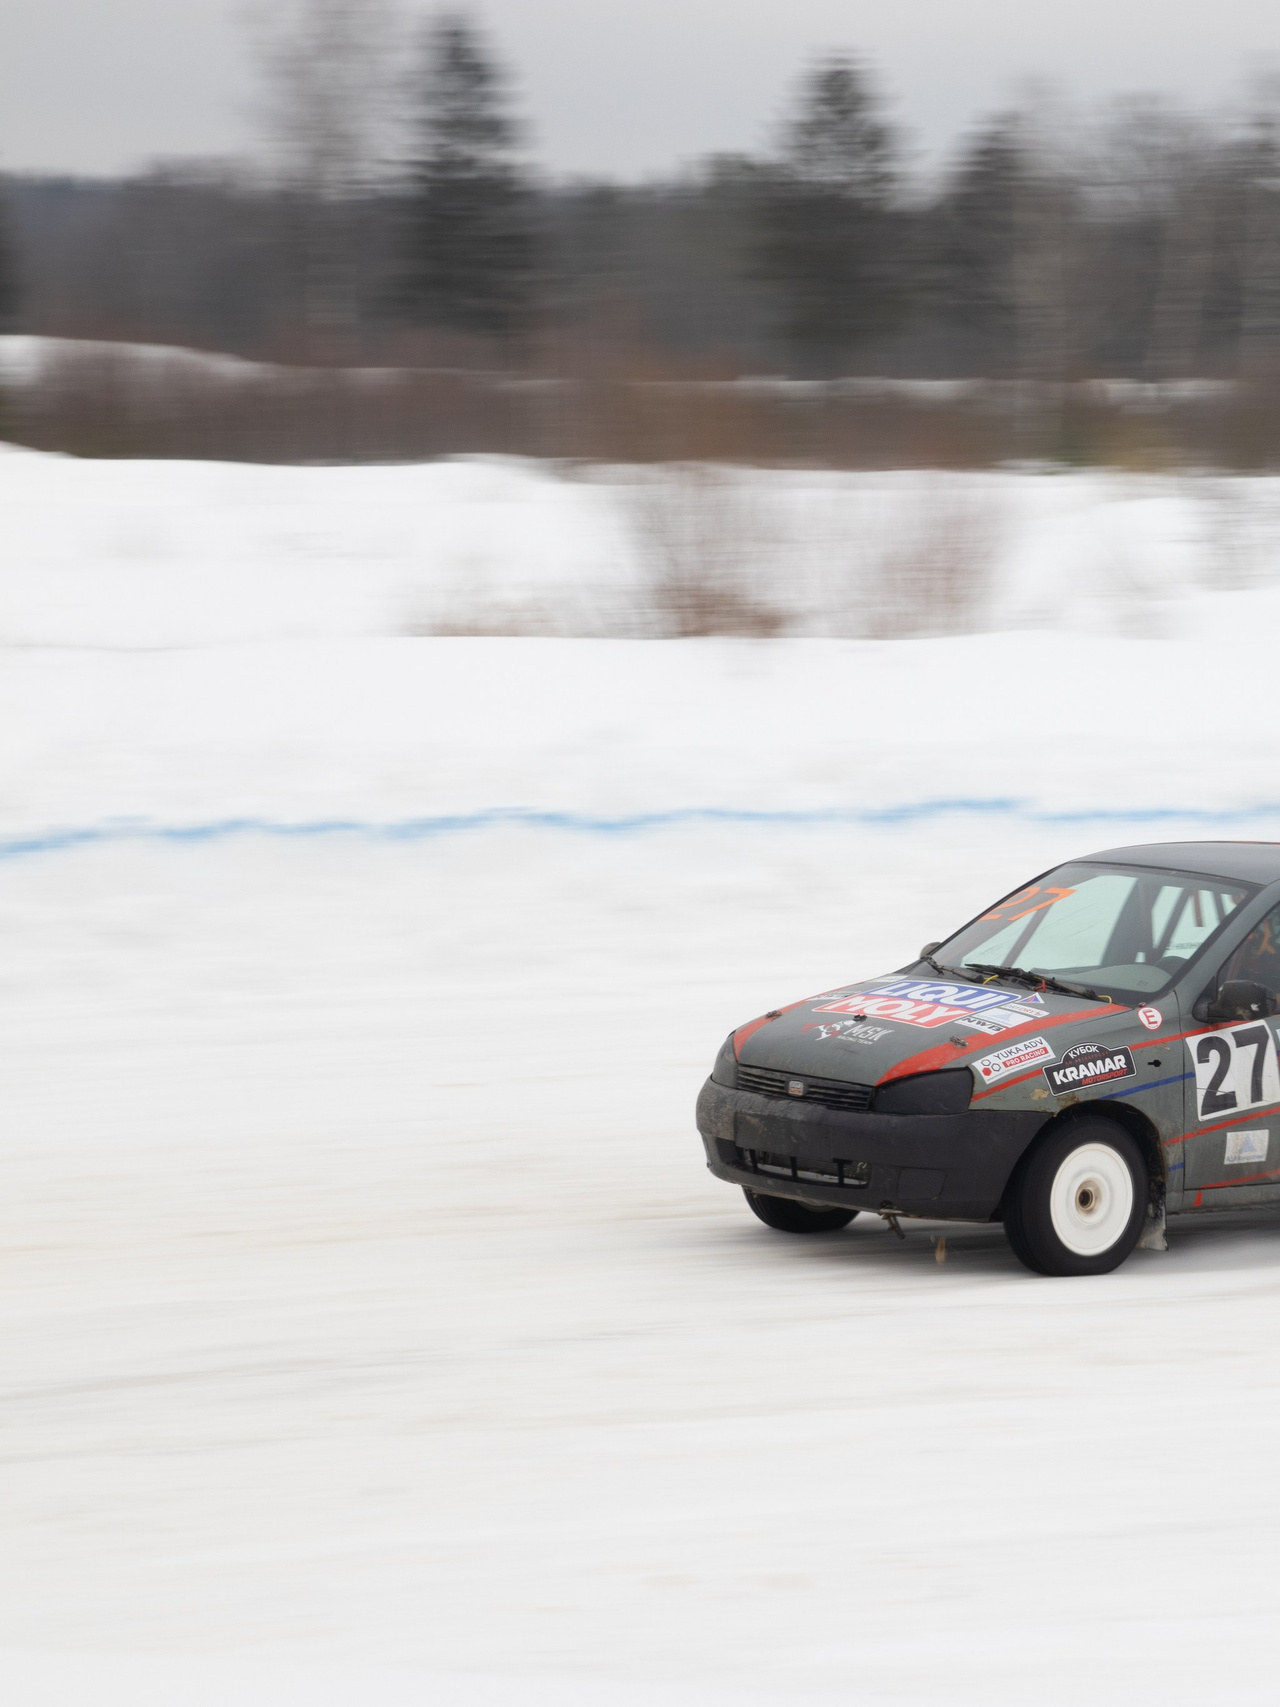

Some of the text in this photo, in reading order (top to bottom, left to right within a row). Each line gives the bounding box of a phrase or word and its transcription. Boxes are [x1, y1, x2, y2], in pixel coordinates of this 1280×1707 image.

[976, 886, 1077, 921] 27
[868, 983, 1011, 1009] LIQUI
[824, 996, 969, 1024] MOLY
[1142, 1009, 1158, 1026] E
[843, 1024, 895, 1041] MSK
[993, 1038, 1044, 1061] YUKA ADV
[1006, 1057, 1021, 1067] PRO
[1021, 1048, 1046, 1062] RACING
[1068, 1045, 1099, 1059] КУБОК
[1053, 1055, 1127, 1085] KRAMAR
[1081, 1068, 1128, 1085] MOTORSPORT
[1197, 1025, 1270, 1116] 27
